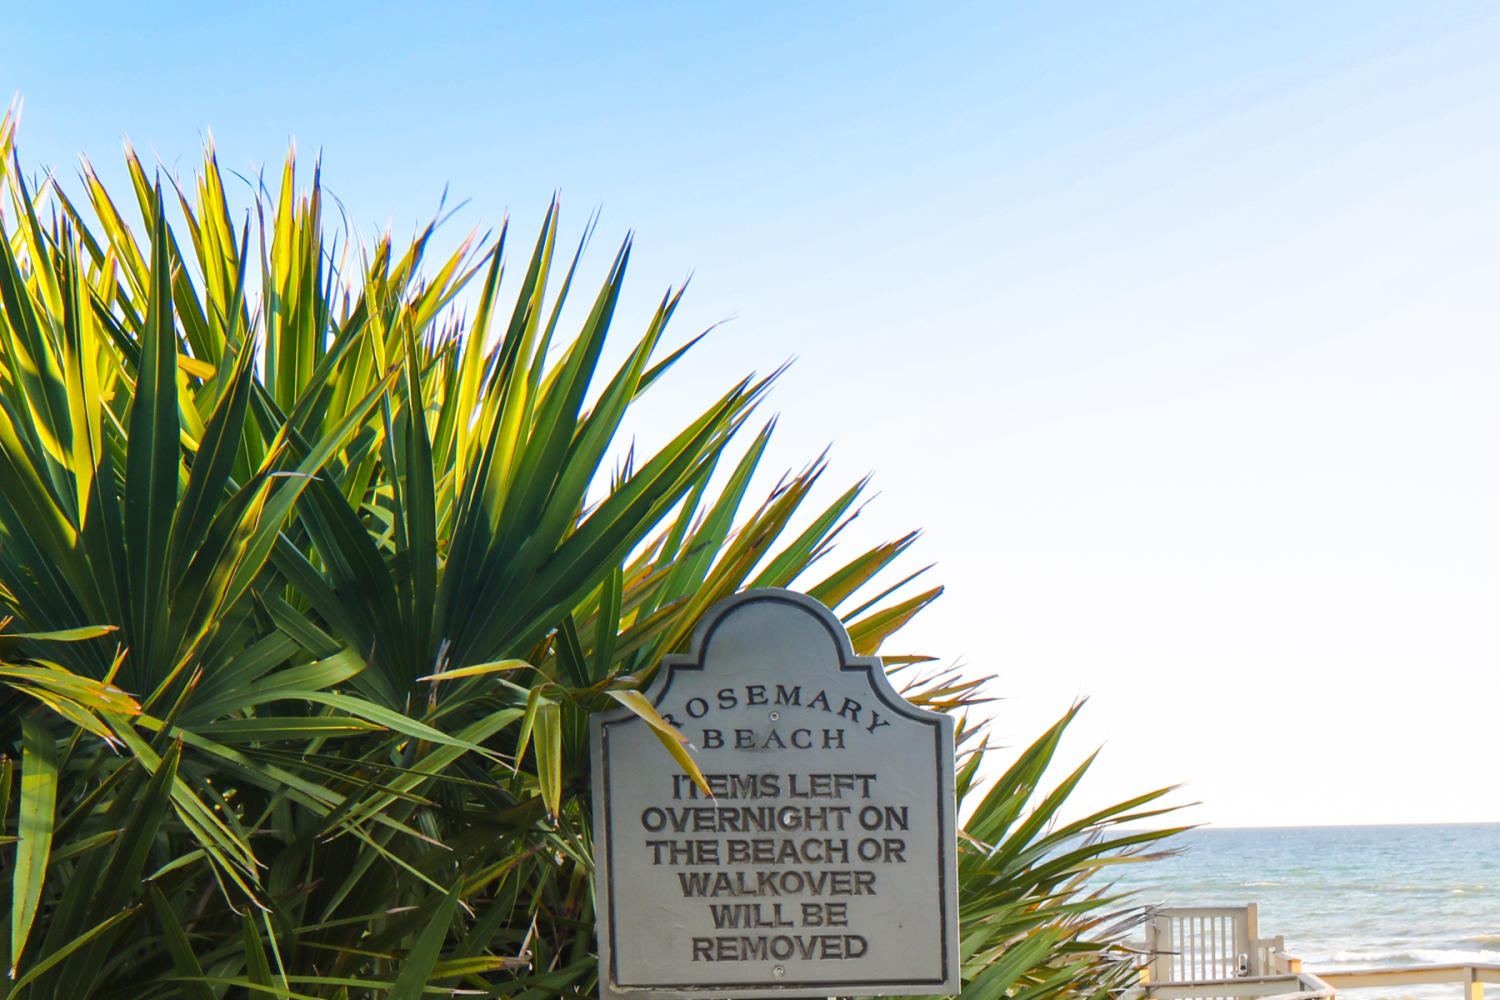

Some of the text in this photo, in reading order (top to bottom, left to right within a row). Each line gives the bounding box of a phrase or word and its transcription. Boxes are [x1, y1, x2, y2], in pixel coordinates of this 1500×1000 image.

[702, 728, 846, 750] BEACH
[671, 772, 877, 801] ITEMS LEFT
[641, 805, 909, 833] OVERNIGHT ON
[645, 837, 907, 866] THE BEACH OR
[677, 870, 877, 898] WALKOVER
[709, 902, 849, 930] WILL BE
[690, 934, 869, 962] REMOVED
